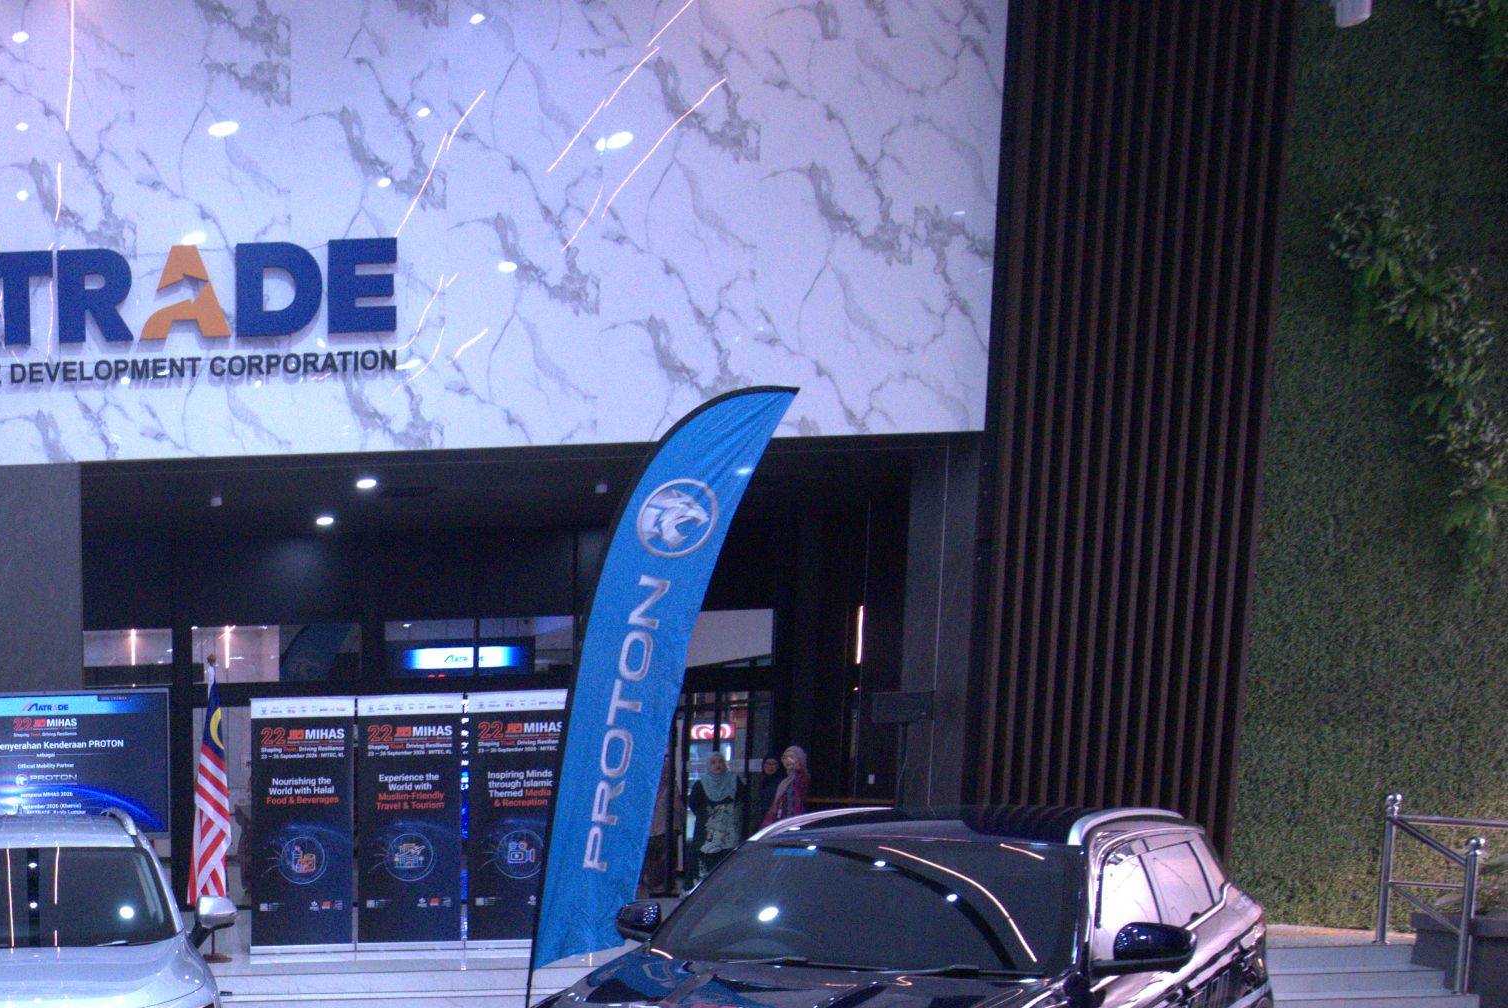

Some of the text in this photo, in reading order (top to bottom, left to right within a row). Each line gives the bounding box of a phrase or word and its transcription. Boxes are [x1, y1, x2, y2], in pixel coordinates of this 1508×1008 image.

[10, 357, 201, 385] DEVELOPMENT
[210, 350, 396, 377] CORPORATION
[21, 703, 68, 712] MATRADE
[47, 718, 77, 727] MIHAS
[582, 574, 671, 872] PROTON
[367, 724, 452, 742] 22 MIHAS
[478, 721, 562, 739] 22 MIHAS
[261, 727, 345, 745] 22 MIHAS
[88, 740, 124, 748] PROTON
[379, 774, 424, 782] Experience
[487, 770, 553, 780] Inspiring Minds
[272, 777, 316, 786] Nourishing
[488, 780, 521, 789] through
[313, 786, 334, 794] Halal
[297, 796, 339, 804] Beverages
[378, 792, 444, 800] Muslim-Friendly
